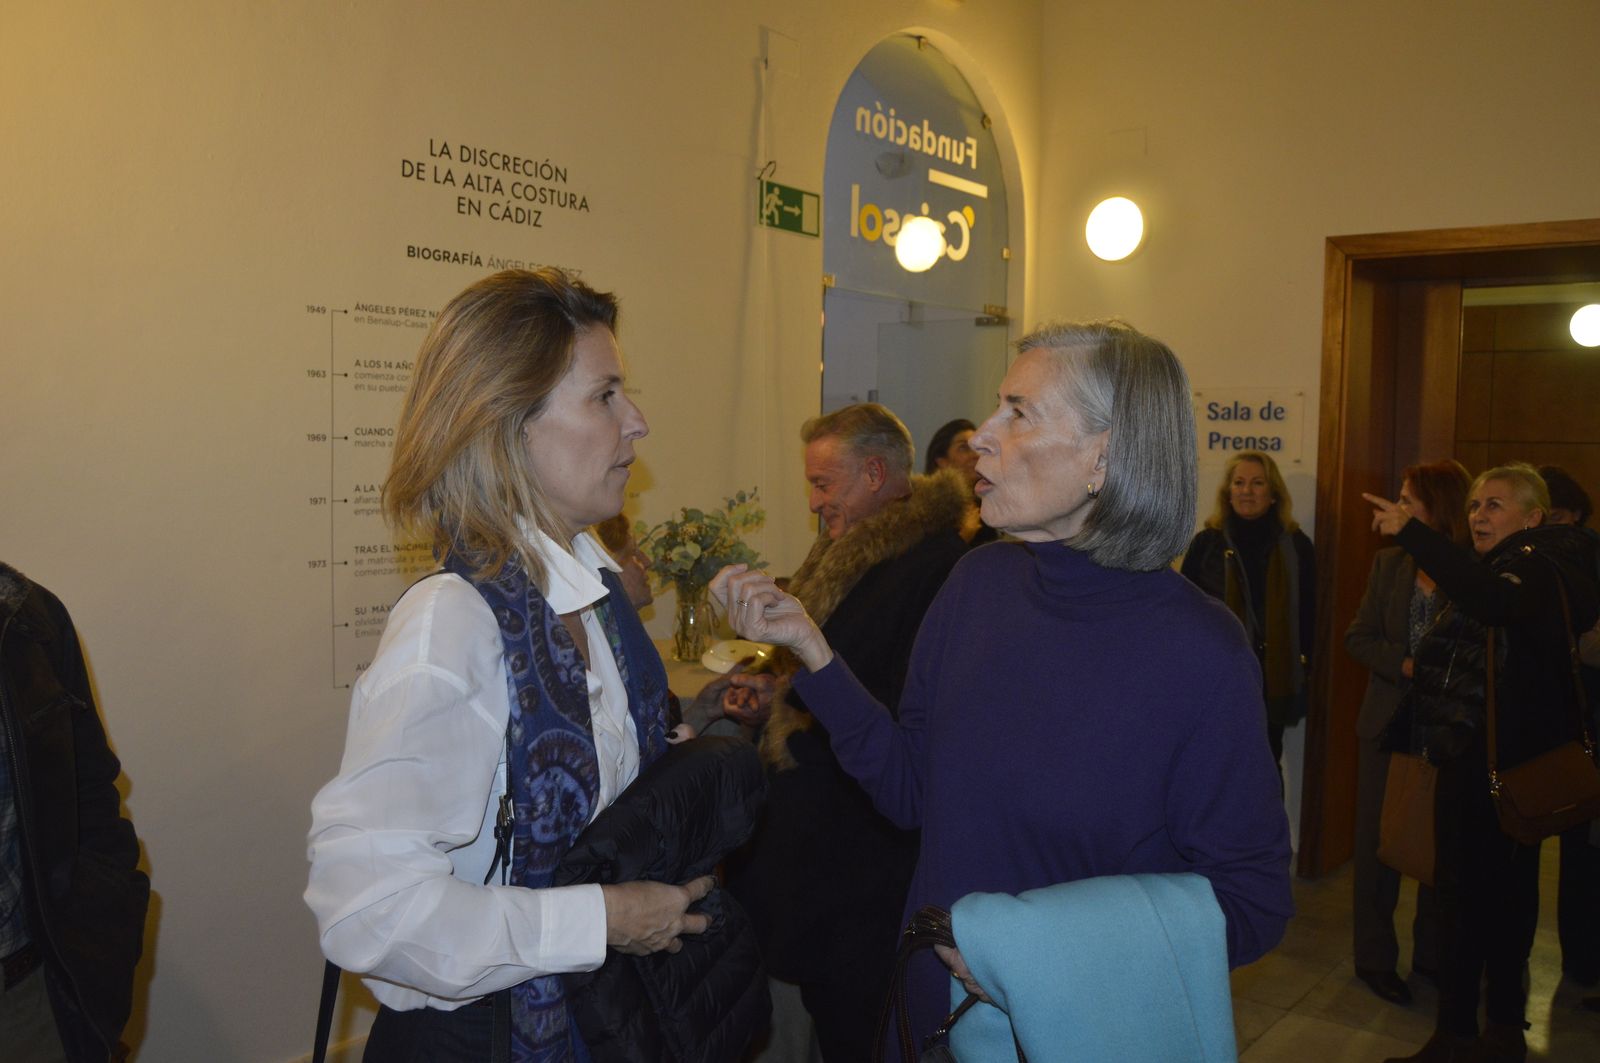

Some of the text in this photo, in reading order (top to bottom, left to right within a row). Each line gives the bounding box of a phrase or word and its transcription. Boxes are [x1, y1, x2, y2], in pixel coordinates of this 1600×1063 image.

[429, 138, 568, 184] LA DISCRECIÓN
[401, 159, 590, 213] DE LA ALTA COSTURA
[456, 196, 543, 228] EN CÁDIZ
[407, 245, 483, 268] BIOGRAFÍA
[306, 304, 327, 314] 1949
[354, 301, 397, 316] ÁNGELES
[398, 306, 427, 319] PÉREZ
[353, 316, 366, 324] en
[354, 359, 415, 370] A LOS 14 AÑO
[306, 369, 327, 379] 1963
[353, 383, 366, 392] en
[1207, 401, 1285, 421] Sala de
[306, 433, 327, 442] 1969
[354, 427, 394, 437] CUANDO
[354, 438, 386, 449] marcha
[1208, 431, 1282, 451] Prensa
[354, 484, 361, 492] A
[363, 484, 375, 493] LA
[309, 497, 327, 505] 1971
[354, 545, 378, 555] TRAS
[380, 544, 391, 553] EL
[308, 560, 327, 569] 1973
[354, 604, 392, 616] SU MÁX
[354, 616, 384, 627] olvidar
